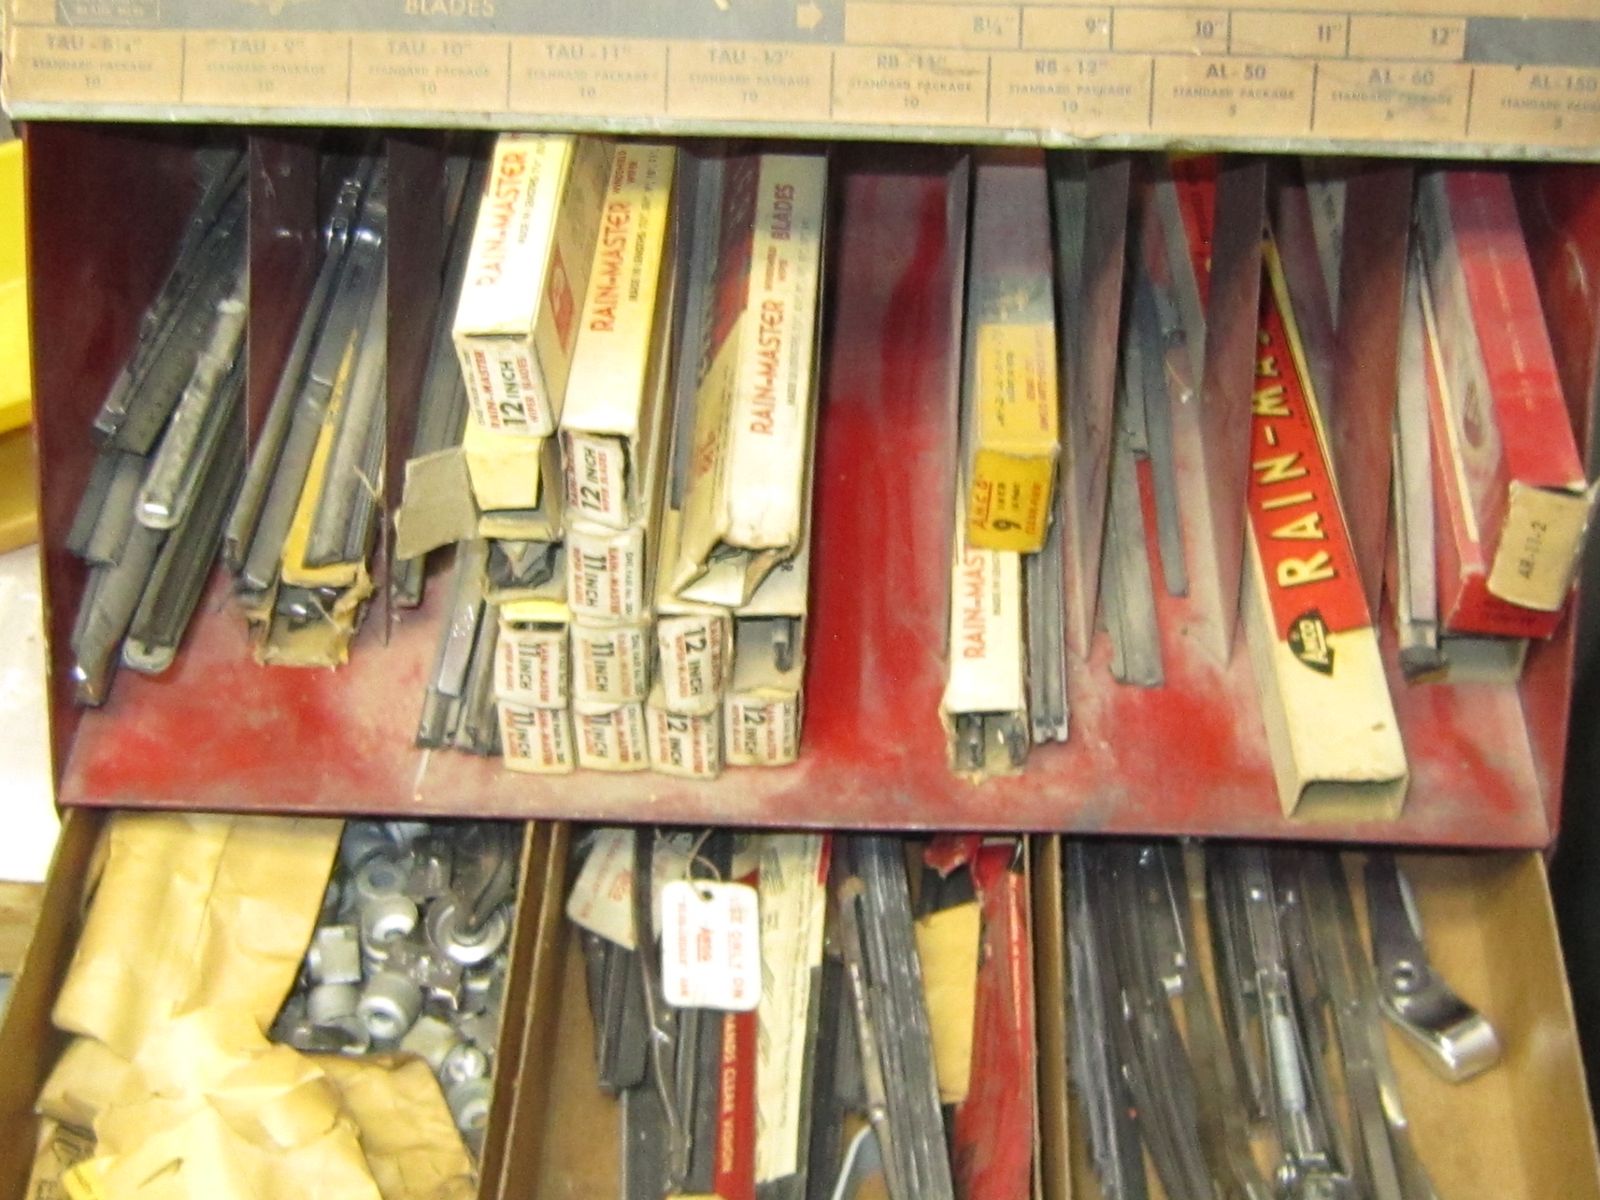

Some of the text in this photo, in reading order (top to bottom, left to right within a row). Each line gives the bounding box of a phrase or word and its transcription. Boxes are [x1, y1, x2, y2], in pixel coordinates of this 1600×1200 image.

[405, 0, 496, 17] BLADES
[591, 202, 631, 331] RAIN-MASTER
[750, 299, 784, 436] RAIN-MASTER
[771, 183, 794, 241] BLADES
[500, 360, 527, 427] 12 INCH
[580, 446, 602, 513] 12 INCH
[992, 518, 1022, 533] 9
[583, 554, 607, 607] 11 INCH
[519, 658, 532, 690] INCH
[591, 641, 614, 692] 11 INCH
[684, 627, 706, 696] 12 INCH
[514, 712, 535, 726] 11
[593, 728, 608, 759] INCH
[667, 712, 689, 766] 12 INCH
[743, 706, 766, 756] 12 INCH
[723, 1067, 737, 1112] CLEAR
[721, 1118, 735, 1173] VISION
